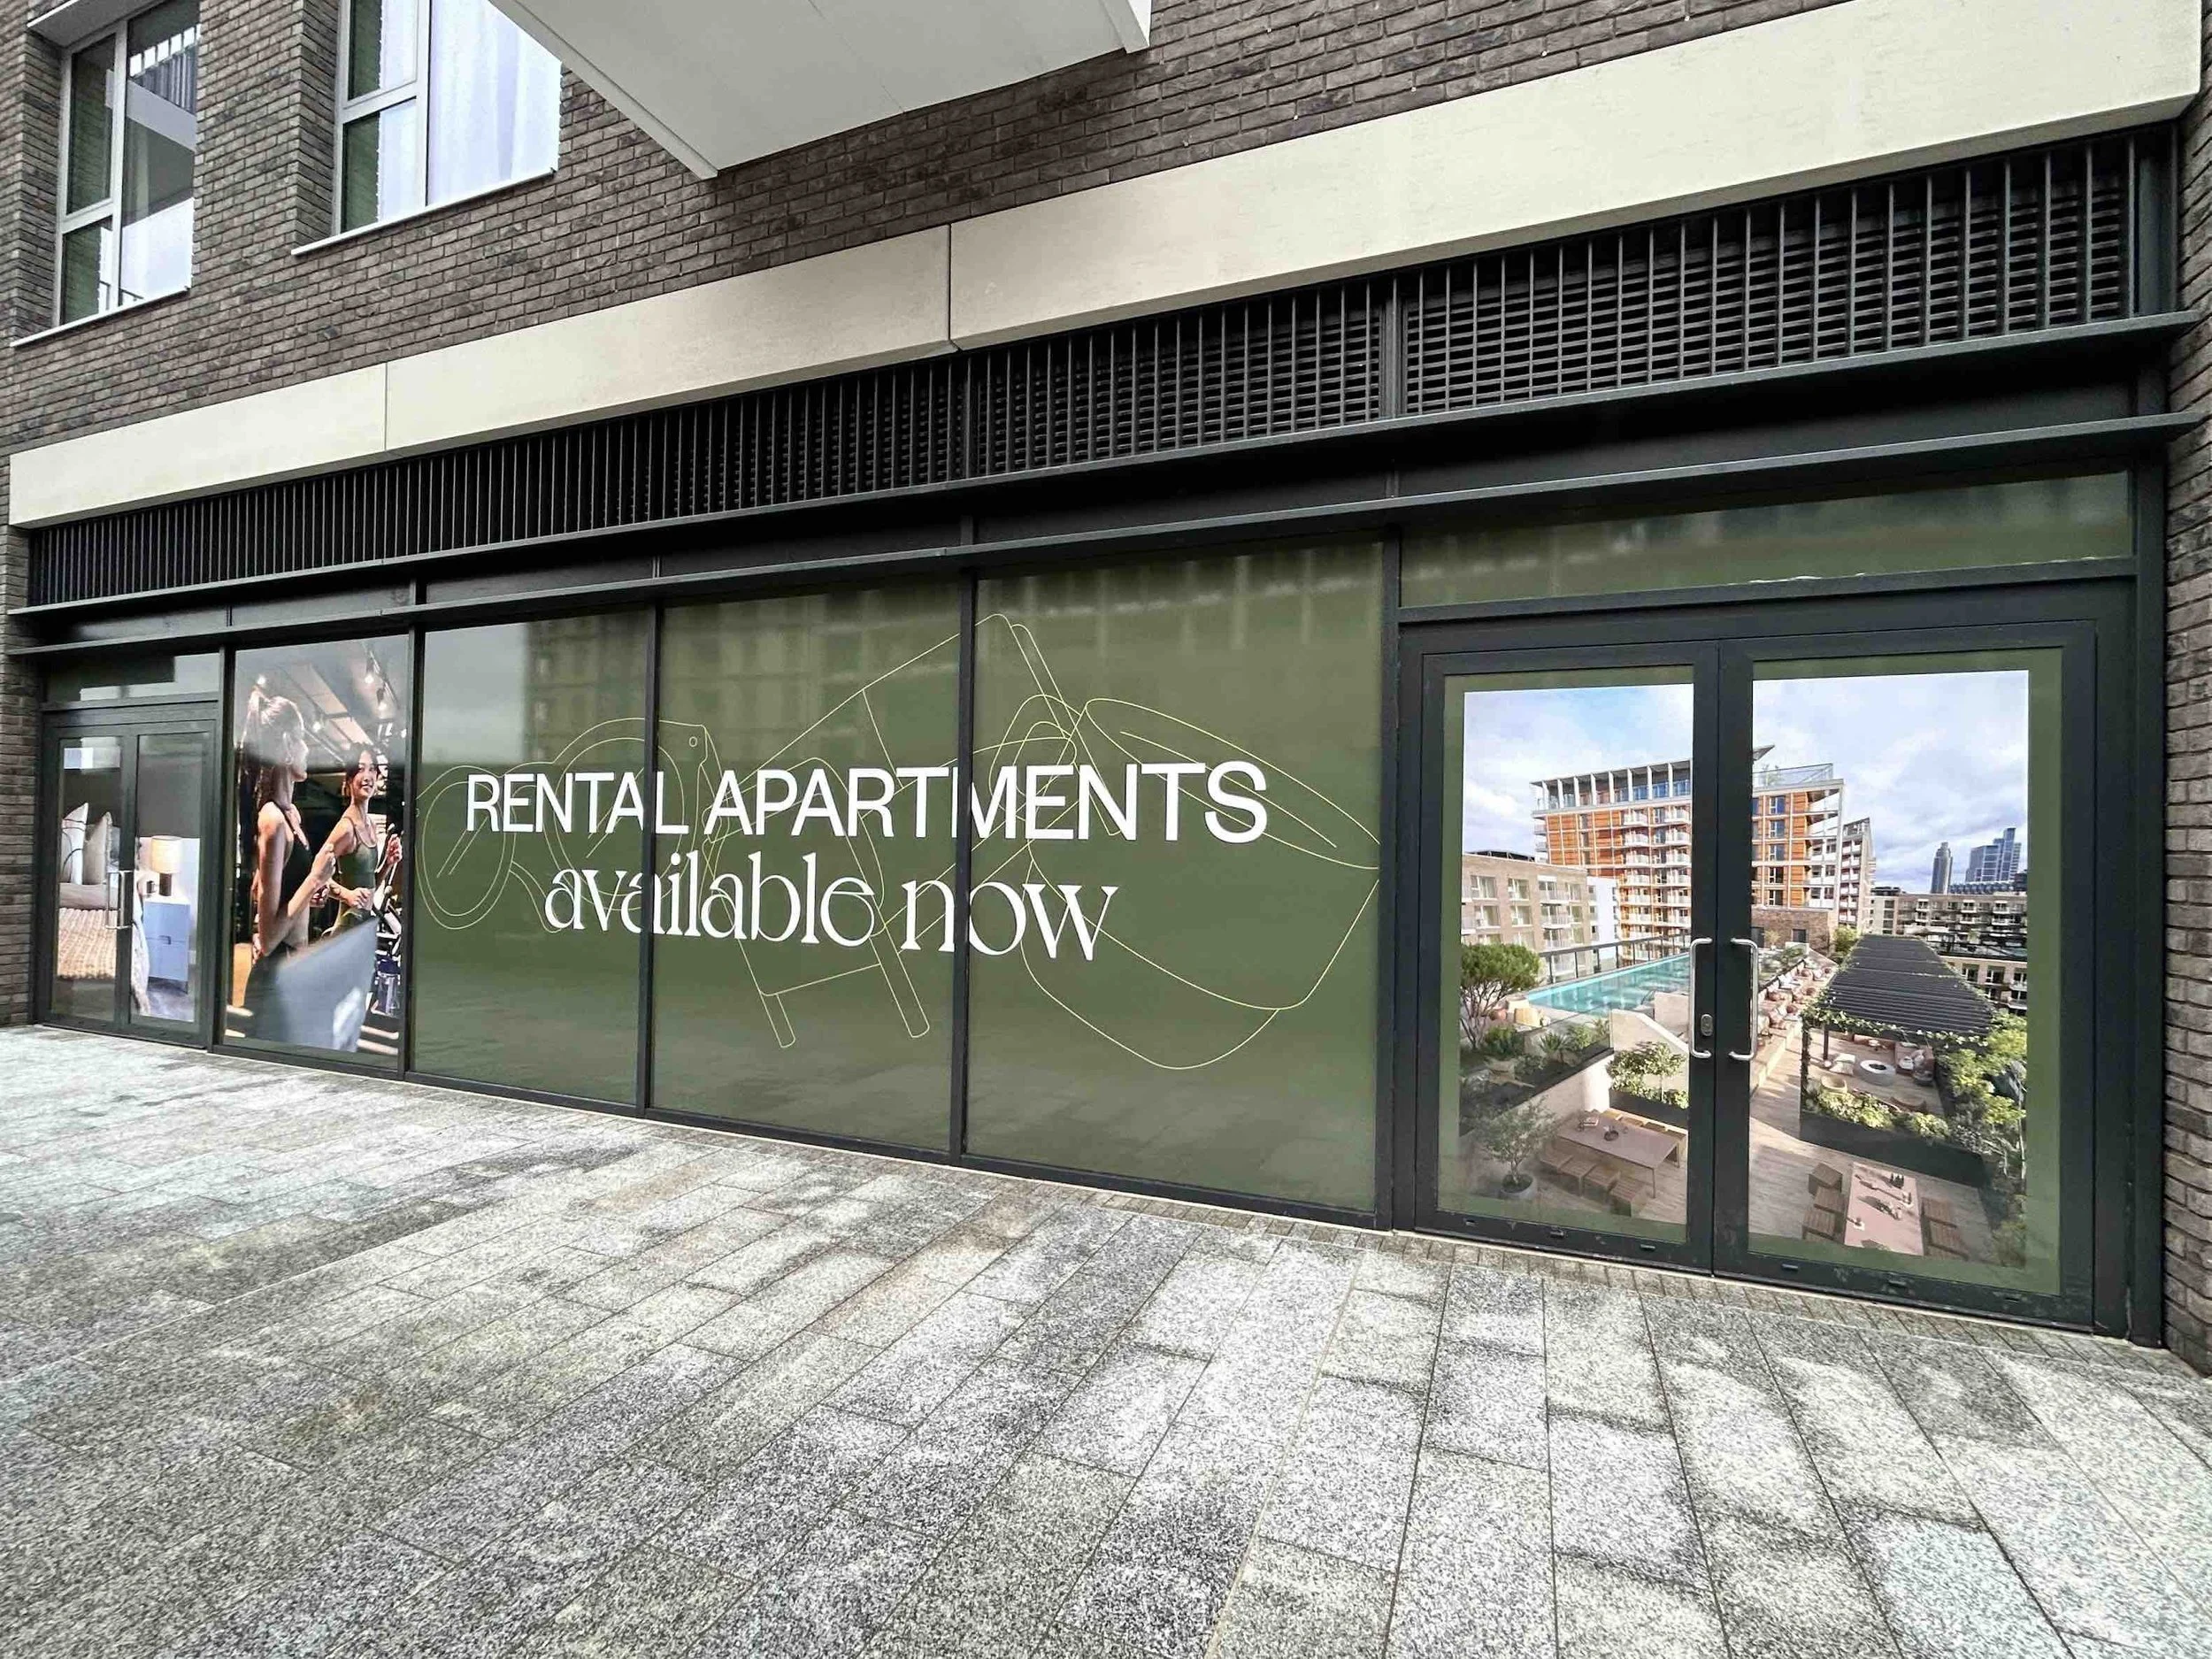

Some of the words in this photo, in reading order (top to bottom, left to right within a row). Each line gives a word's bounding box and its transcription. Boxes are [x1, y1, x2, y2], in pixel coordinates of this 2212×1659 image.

[465, 768, 689, 835] RENTAL
[703, 761, 1269, 843] APARTMENTS
[544, 850, 876, 947] available
[900, 879, 1119, 961] now
